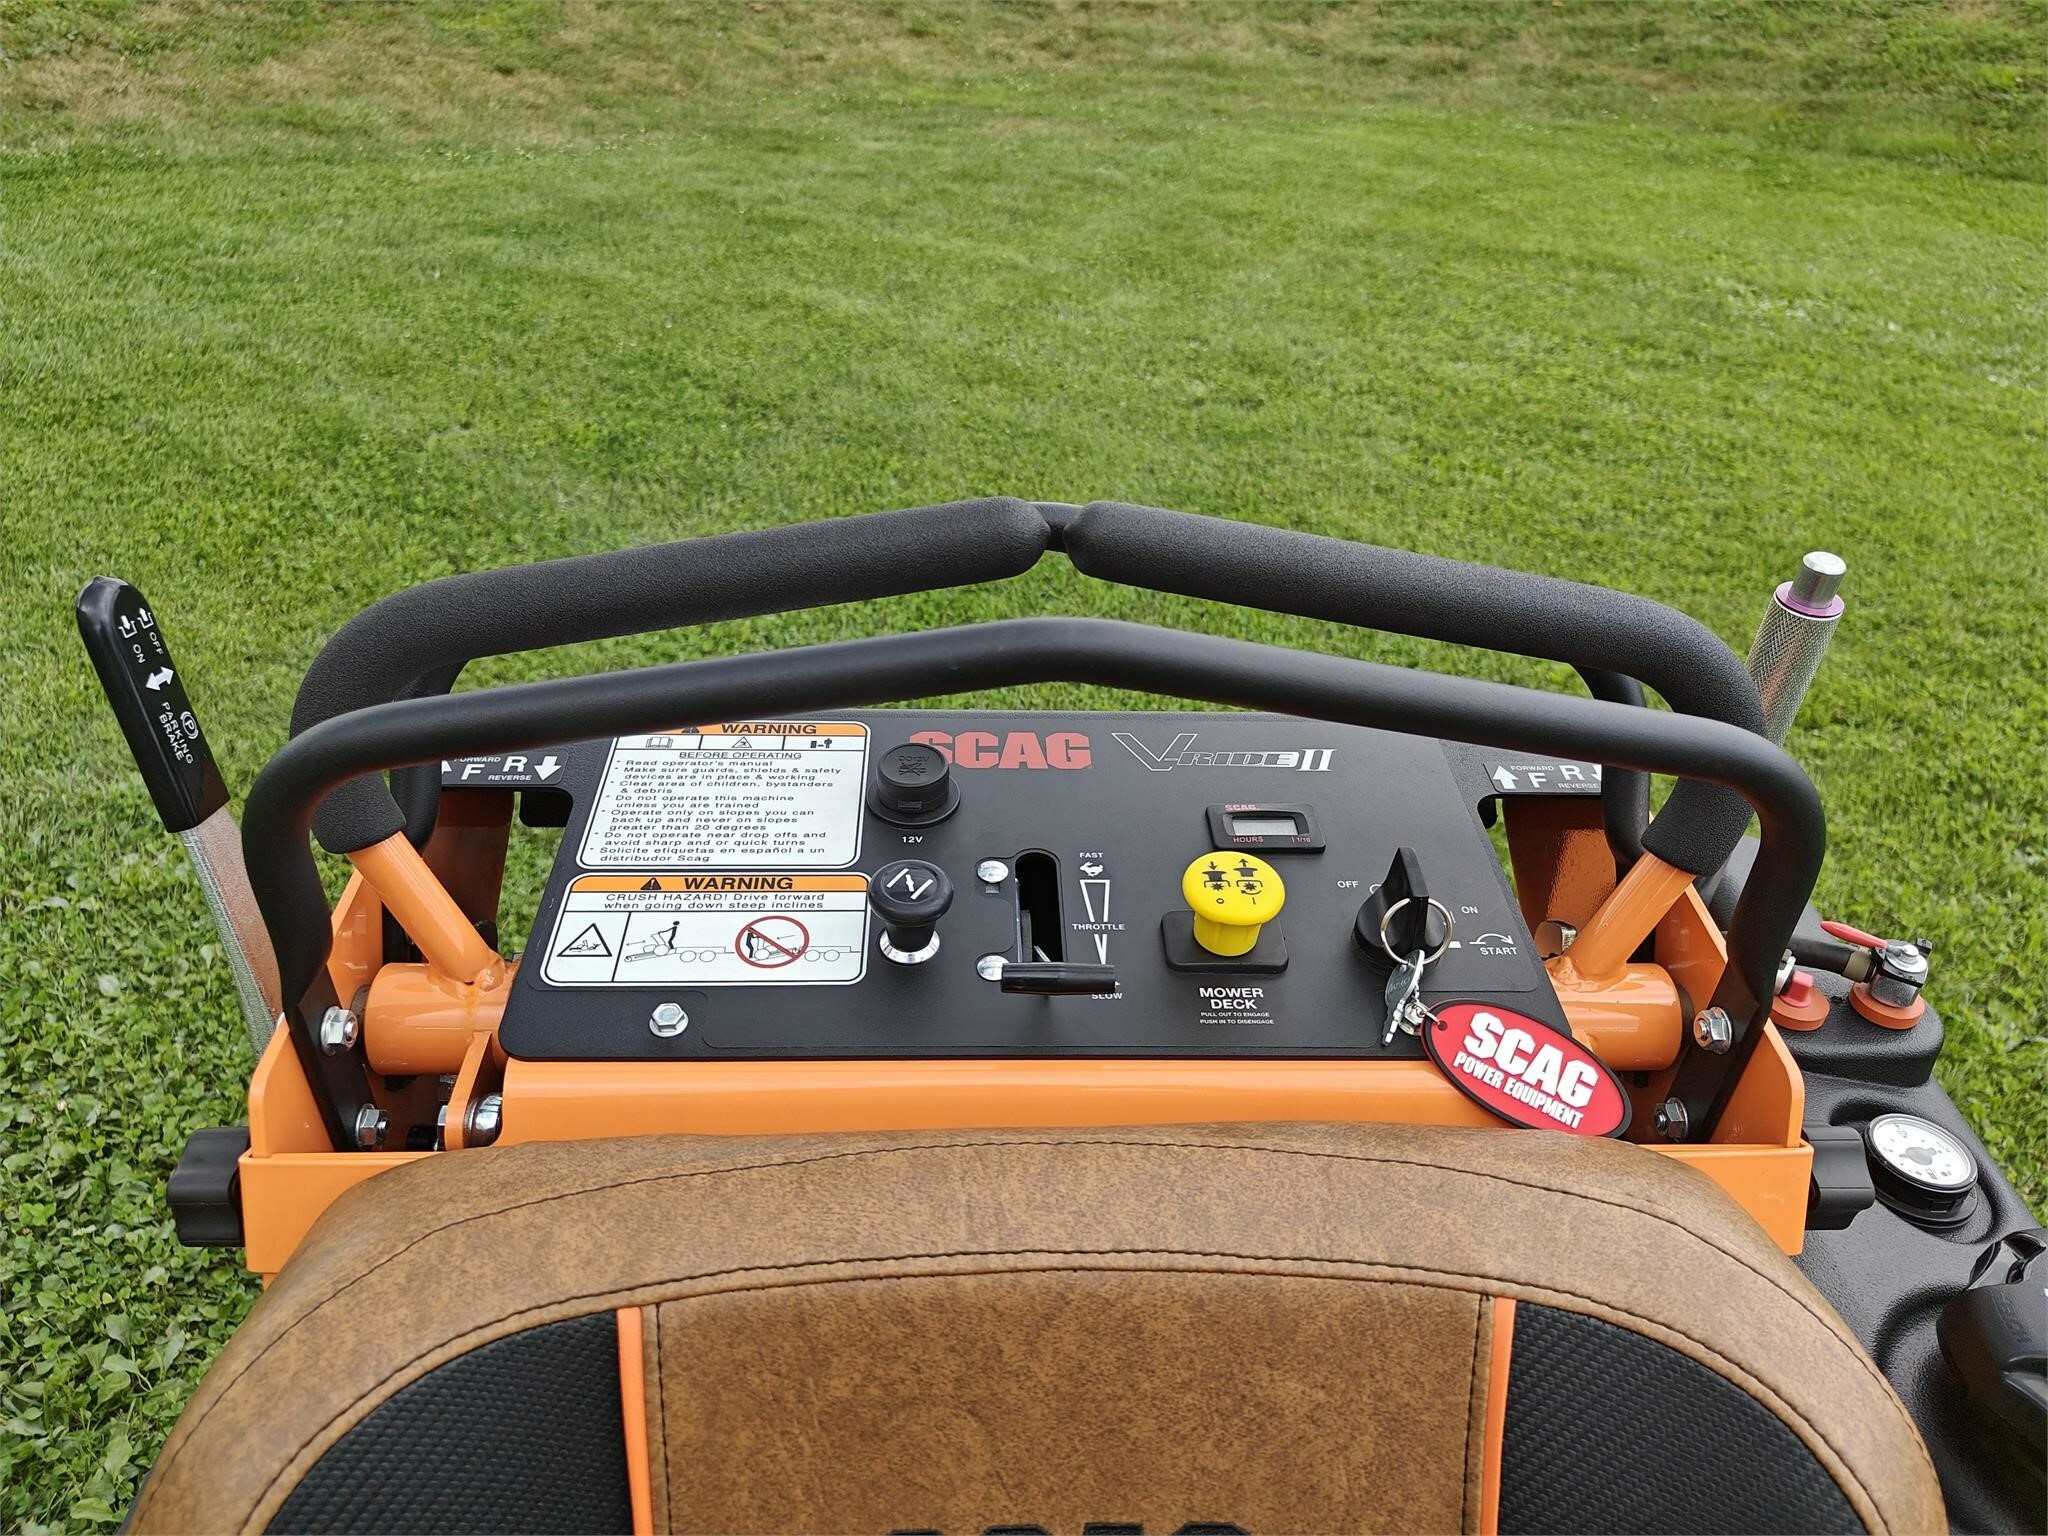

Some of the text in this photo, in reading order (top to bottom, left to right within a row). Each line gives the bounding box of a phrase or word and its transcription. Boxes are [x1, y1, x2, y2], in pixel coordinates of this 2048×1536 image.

[150, 632, 164, 655] OFF
[133, 644, 146, 663] ON
[161, 701, 194, 764] PARKING
[722, 724, 817, 735] WARNING
[159, 715, 183, 760] BRAKE
[909, 731, 1093, 769] SCAG
[732, 752, 802, 760] OPERATING
[1296, 749, 1338, 772] II
[502, 756, 528, 772] R
[461, 763, 486, 780] F
[1558, 765, 1585, 780] R
[1527, 772, 1548, 788] F
[902, 835, 923, 843] 12V
[654, 847, 715, 855] etiquetas
[740, 847, 792, 855] español
[677, 855, 710, 863] Scag
[684, 877, 794, 890] WARNING
[1337, 881, 1359, 889] OFF
[733, 893, 769, 901] Drive
[774, 893, 825, 901] forward
[645, 902, 682, 910] going
[728, 902, 766, 910] steep
[1461, 906, 1479, 915] ON
[1072, 923, 1126, 931] THROTTLE
[1479, 947, 1517, 956] START
[1091, 992, 1123, 1000] SLOW
[1199, 987, 1264, 998] MOWER
[1210, 999, 1258, 1010] DECK
[1463, 1012, 1599, 1108] SCAG
[1453, 1050, 1584, 1129] POWER EQUIPMENT
